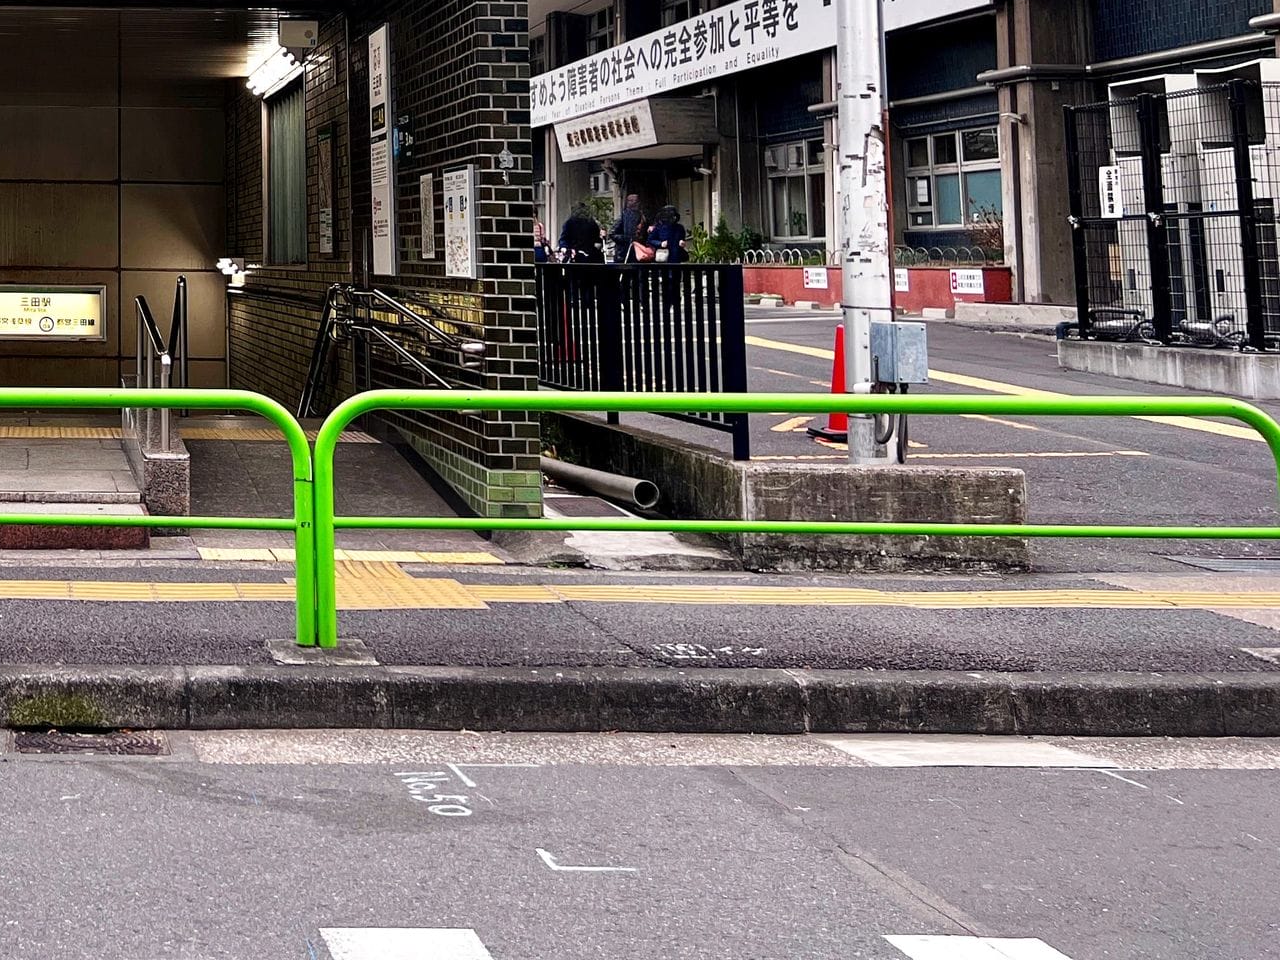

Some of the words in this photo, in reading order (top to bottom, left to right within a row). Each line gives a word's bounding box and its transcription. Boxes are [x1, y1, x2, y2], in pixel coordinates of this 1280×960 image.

[626, 86, 644, 96] Theme
[655, 78, 667, 89] Full
[673, 65, 717, 83] Participation
[725, 57, 738, 70] and
[747, 47, 780, 64] Equality
[20, 297, 51, 307] 三田駅
